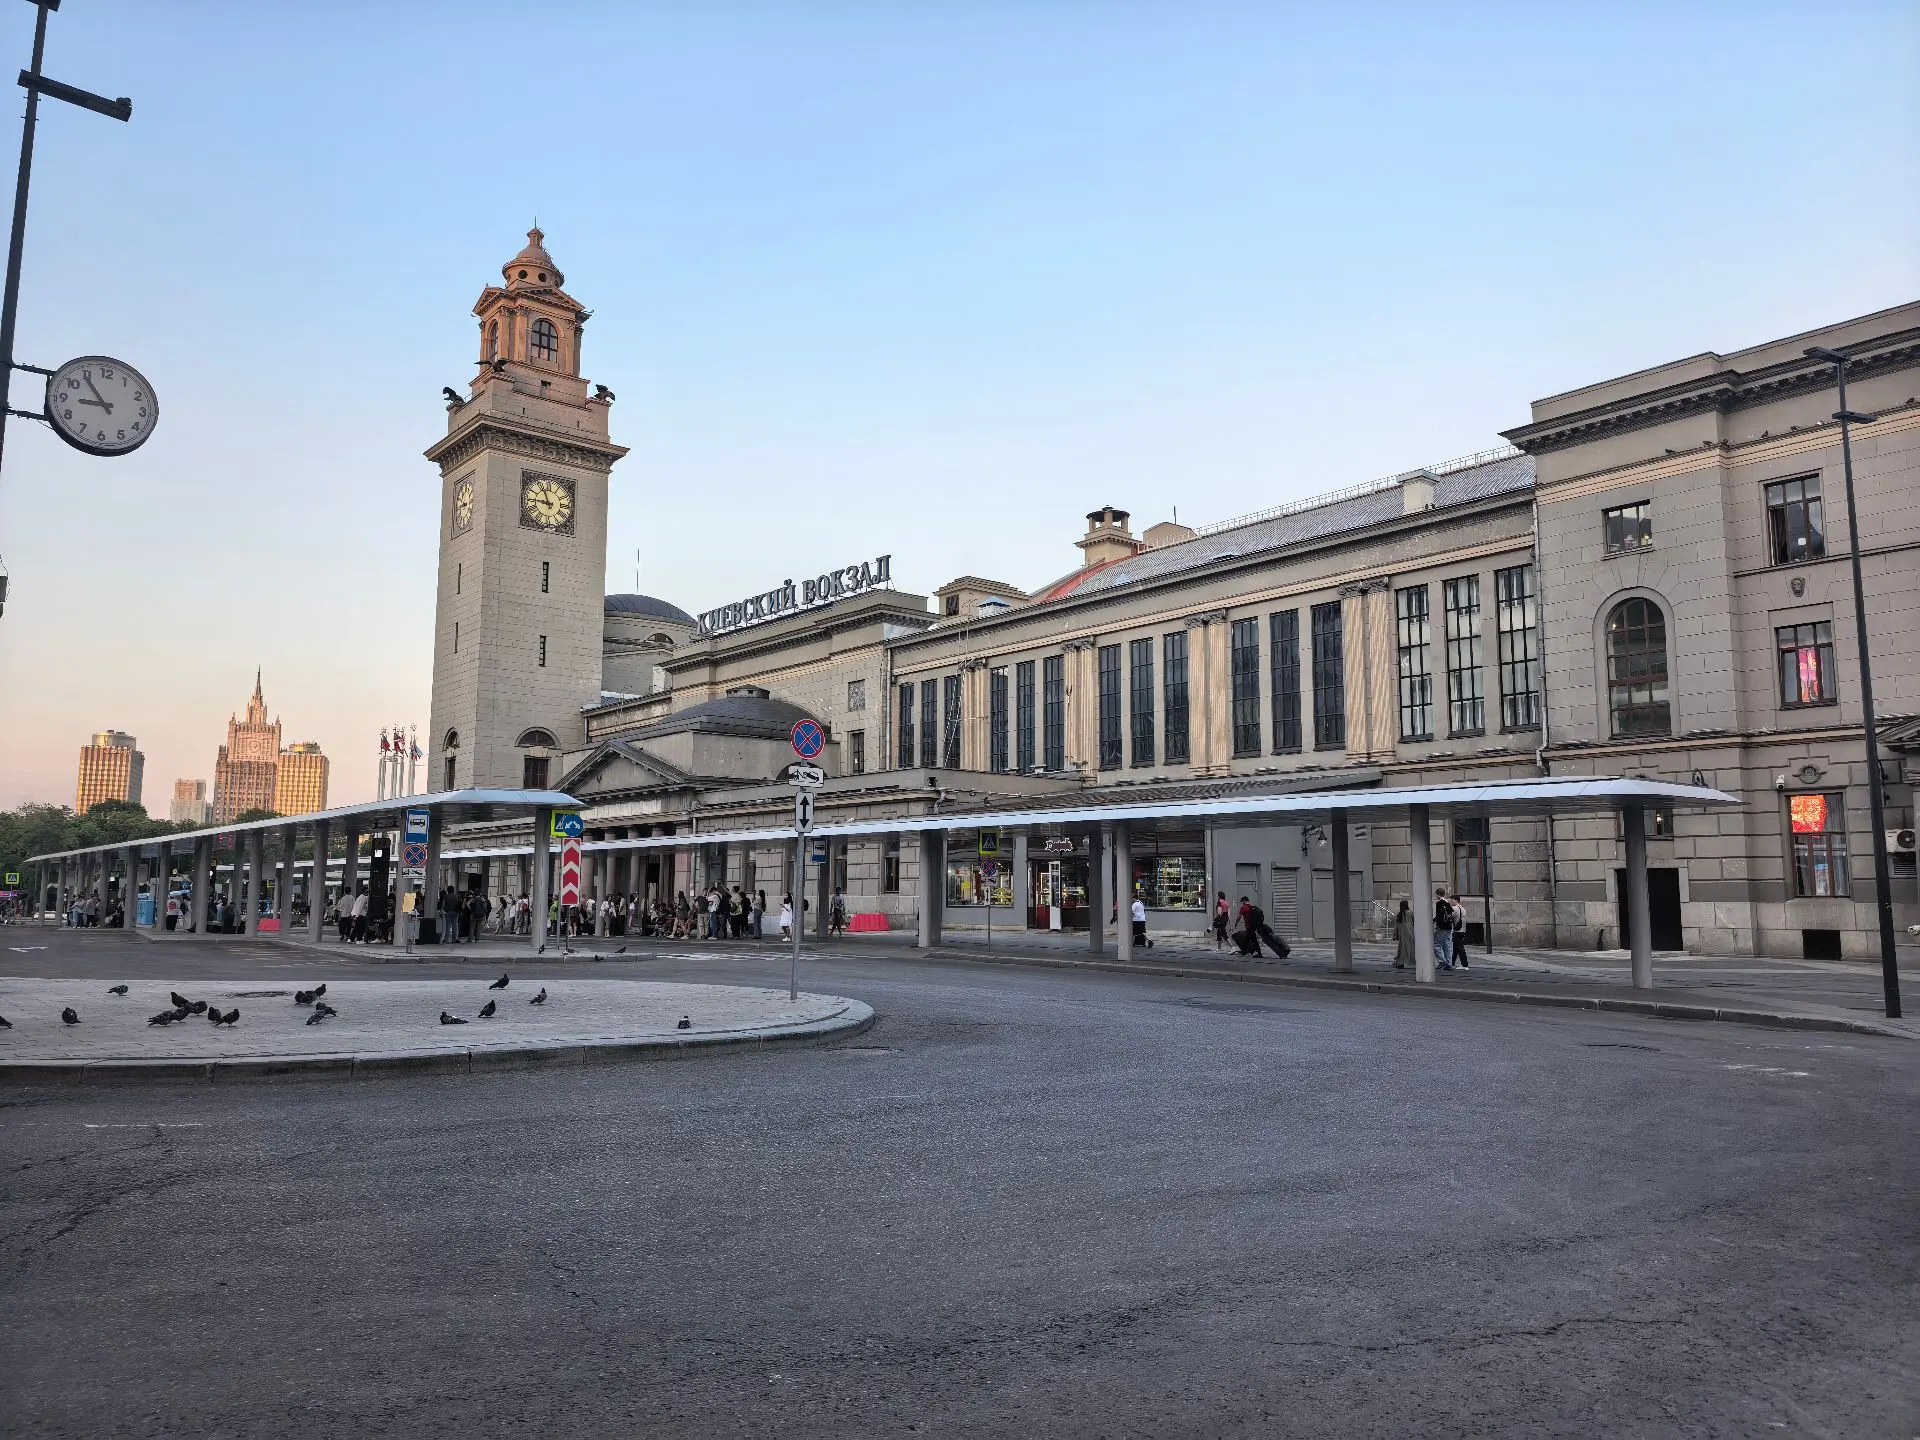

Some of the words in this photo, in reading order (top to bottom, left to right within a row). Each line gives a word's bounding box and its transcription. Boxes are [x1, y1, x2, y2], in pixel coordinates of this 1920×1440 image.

[100, 368, 114, 380] 12
[67, 378, 80, 389] 10
[122, 377, 127, 387] 1
[59, 393, 68, 403] 9
[134, 391, 143, 401] 2
[64, 409, 73, 420] 8
[139, 407, 147, 418] 3
[80, 423, 87, 434] 7
[131, 421, 140, 432] 4
[97, 431, 106, 441] 6
[117, 430, 125, 440] 5
[697, 579, 798, 634] КИЕВСКИЙ
[802, 555, 891, 605] ВОКЗАЛ
